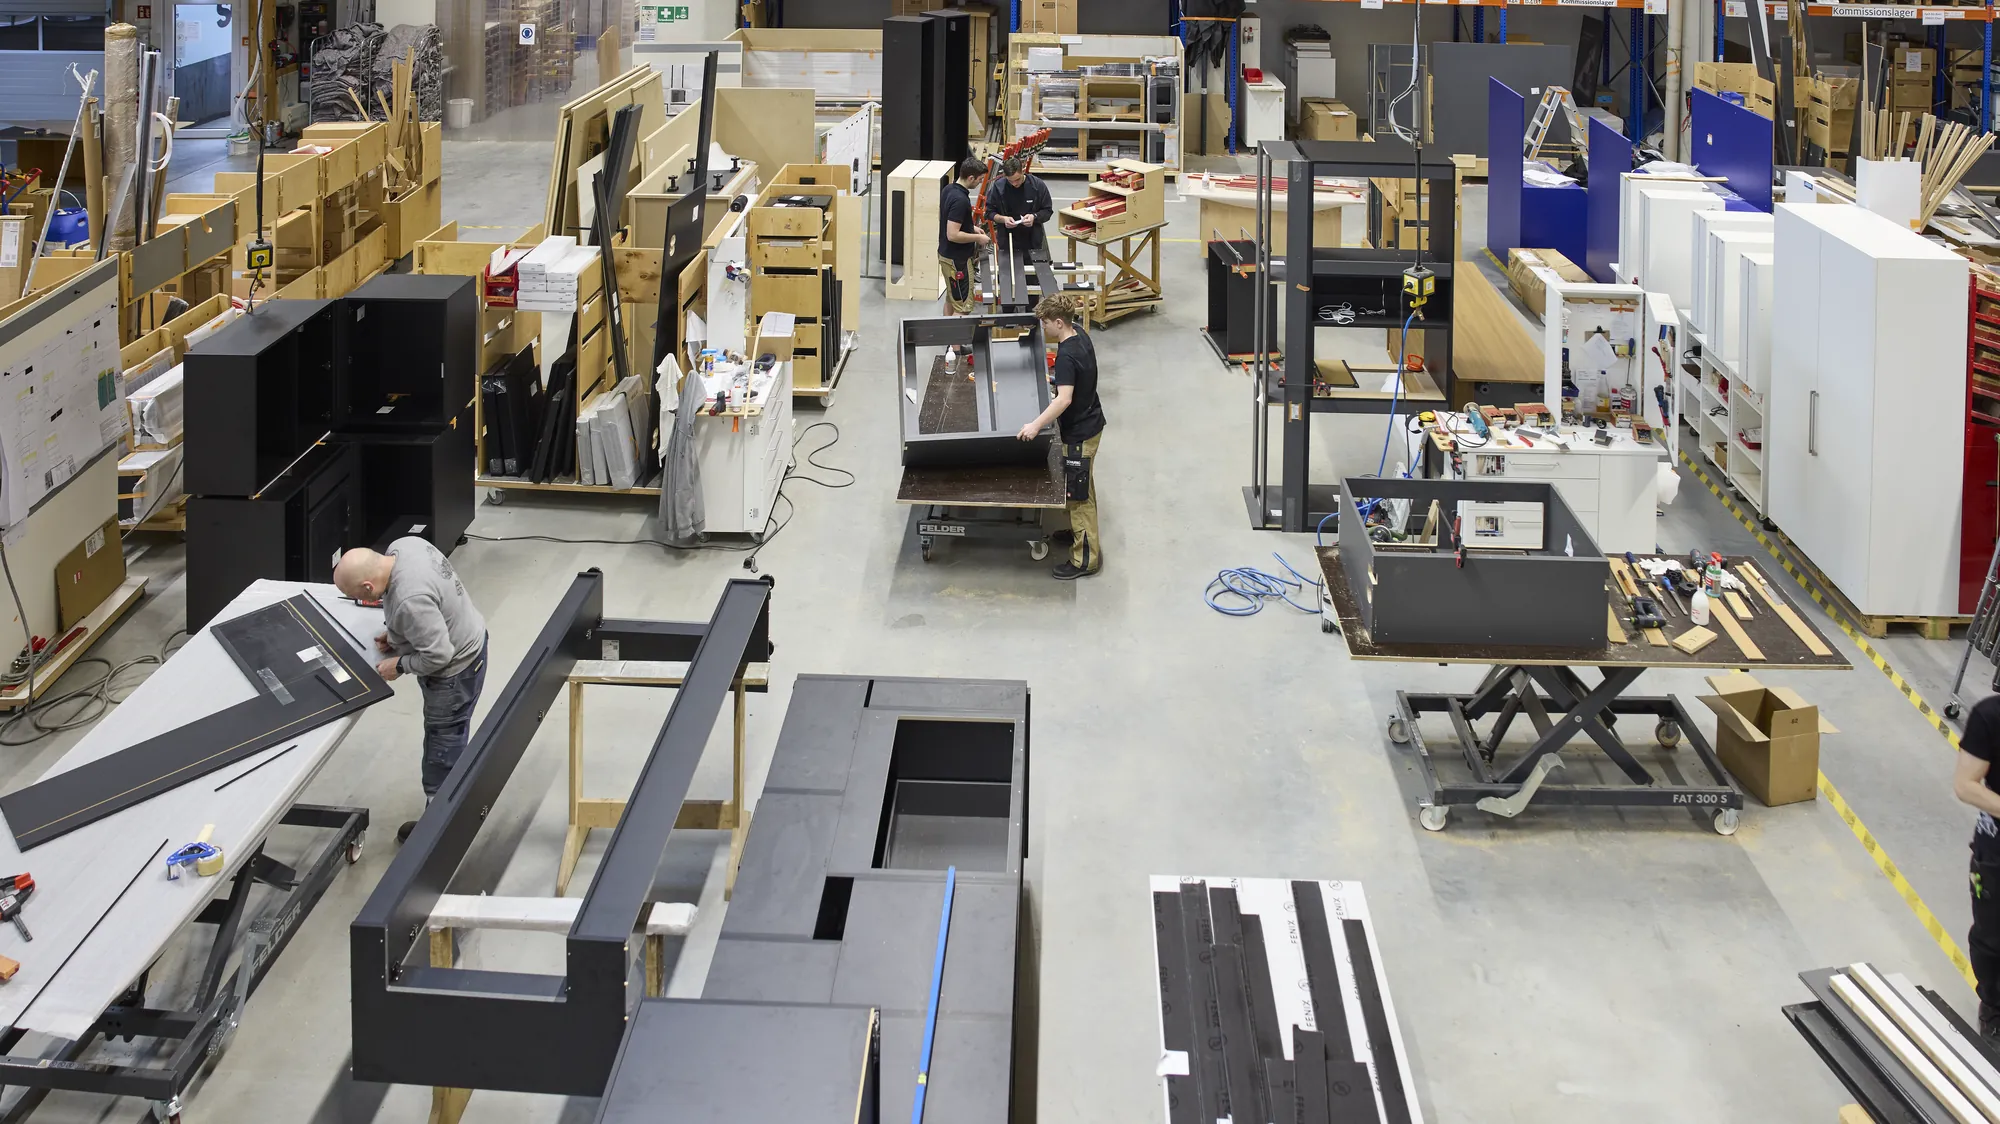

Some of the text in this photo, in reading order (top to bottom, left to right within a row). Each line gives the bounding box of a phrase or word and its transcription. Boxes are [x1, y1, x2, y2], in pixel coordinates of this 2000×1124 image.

[1833, 6, 1915, 18] Kommissionslager
[919, 524, 965, 533] FELDER
[1673, 794, 1728, 803] FAT 300 S
[1334, 897, 1344, 920] FENIX
[251, 901, 301, 978] FELDER
[1201, 919, 1212, 943] FENIX
[1288, 920, 1298, 944] FENIX
[1302, 1000, 1315, 1027] FENIX
